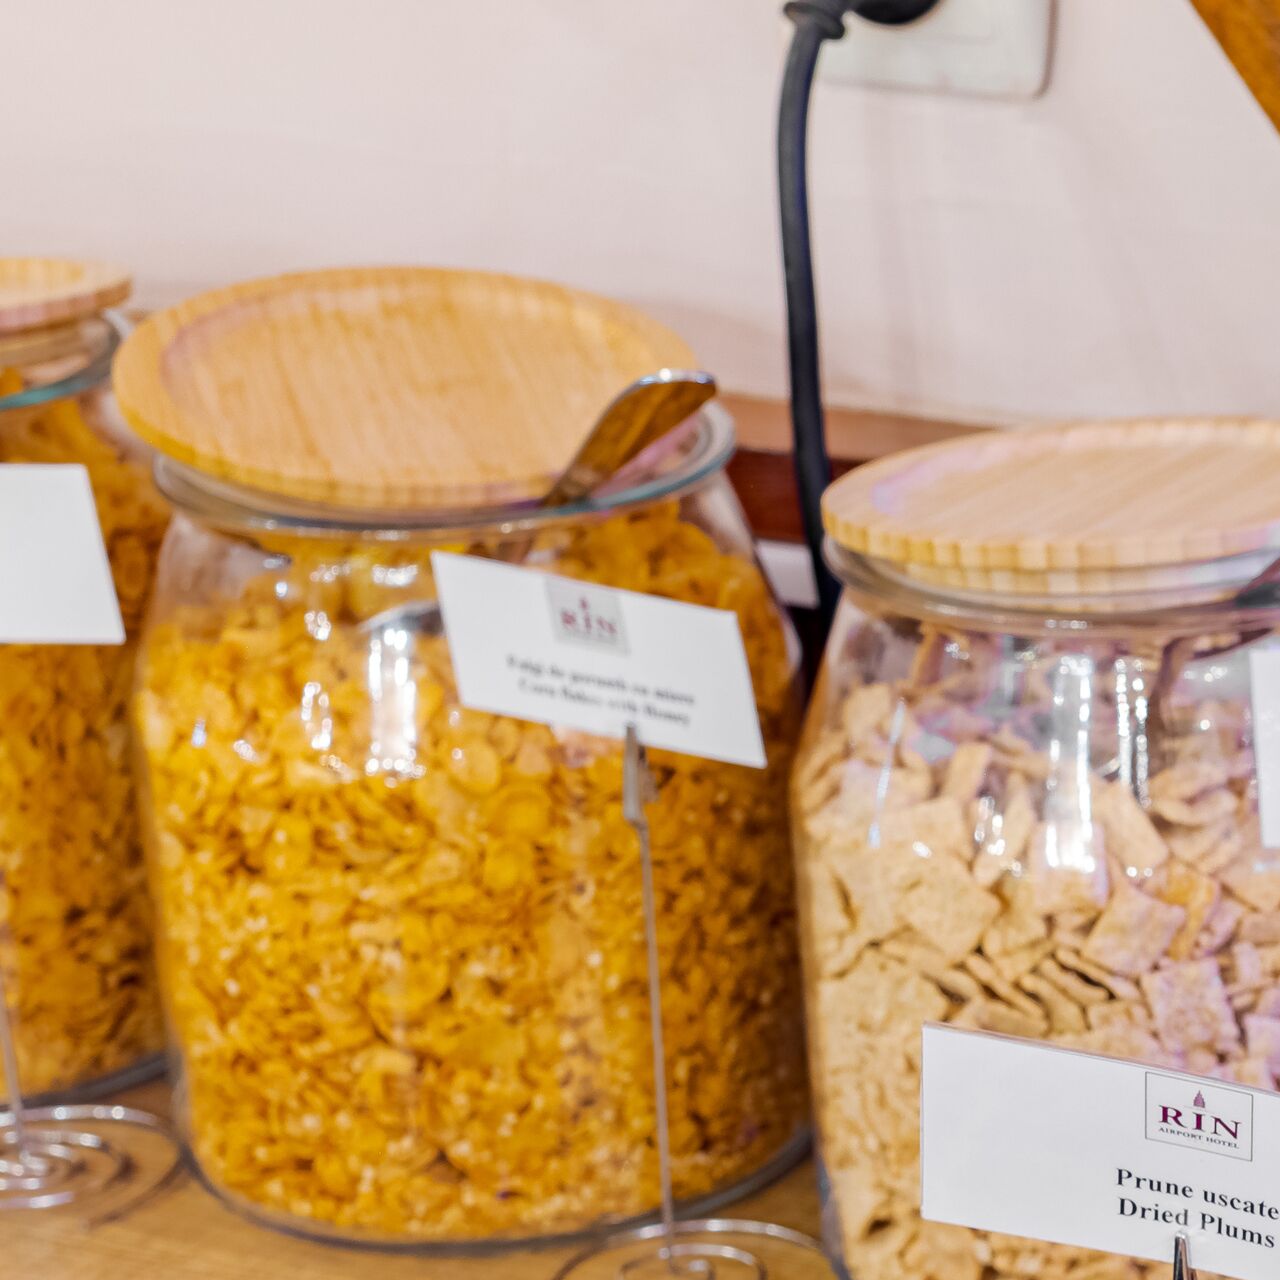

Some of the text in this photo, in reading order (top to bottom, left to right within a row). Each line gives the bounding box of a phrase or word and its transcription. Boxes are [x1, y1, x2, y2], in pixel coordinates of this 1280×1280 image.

[1158, 1105, 1242, 1140] RIN
[1158, 1127, 1240, 1149] AIRPORT HOTEL
[1116, 1168, 1280, 1220] Prune uscate
[1117, 1197, 1276, 1248] Dried Plums
